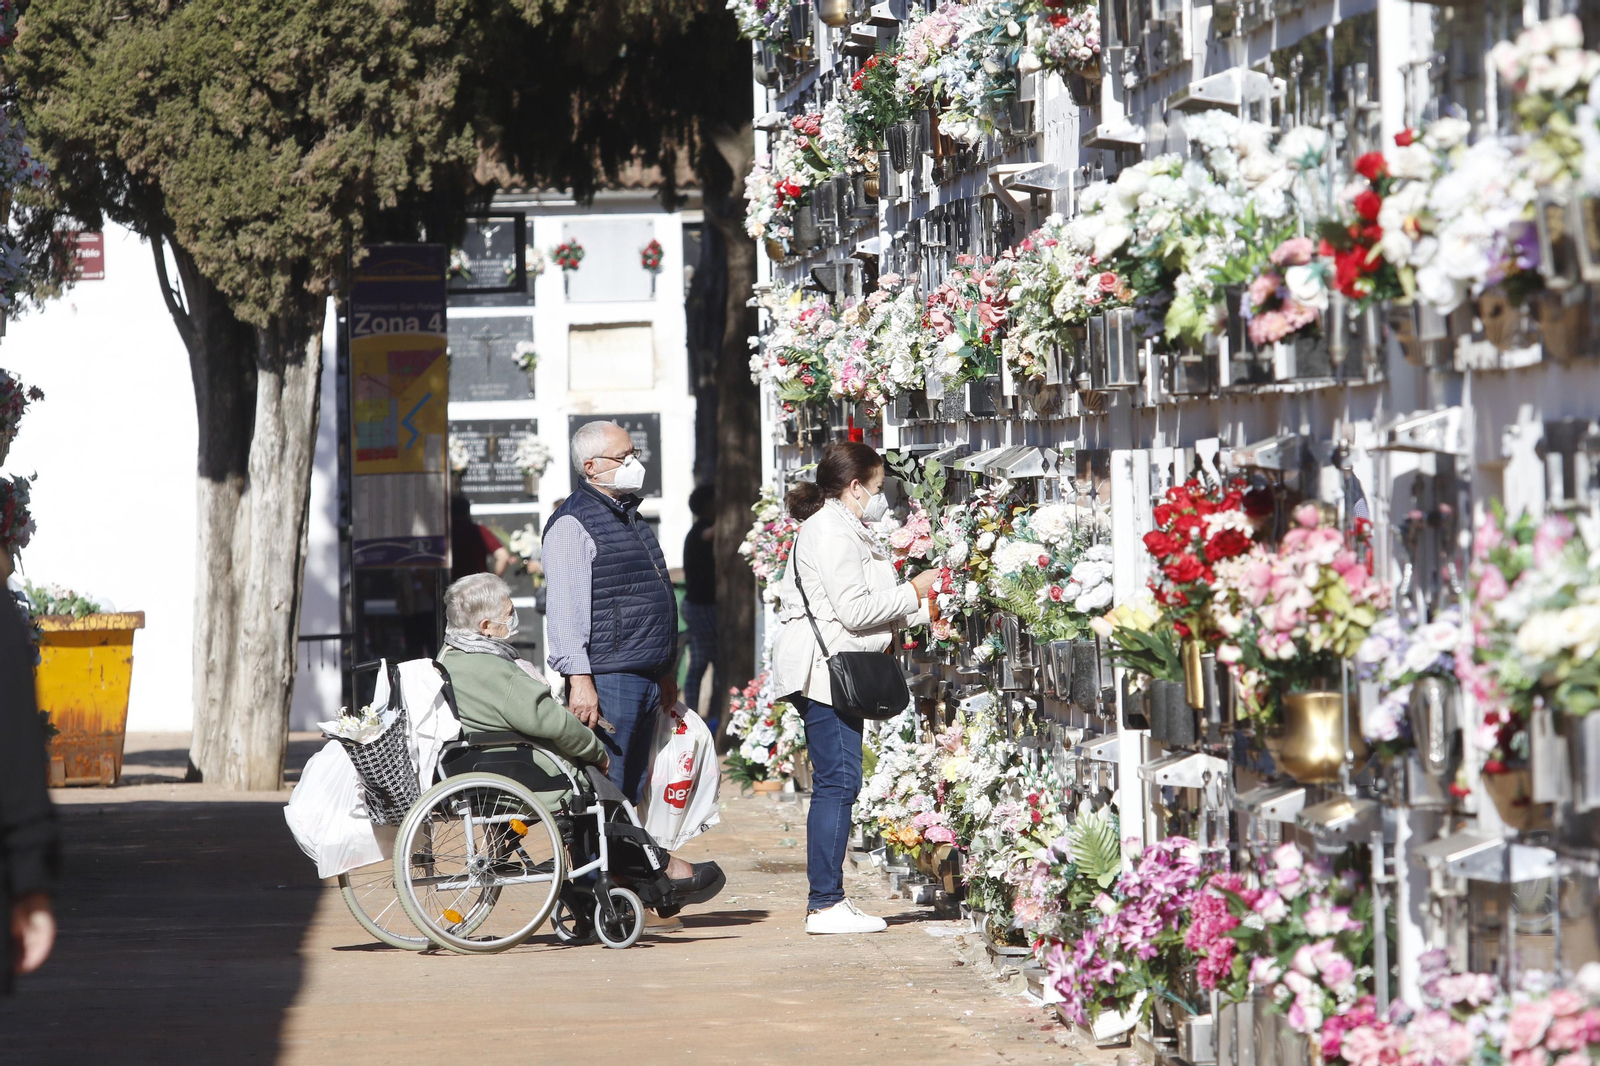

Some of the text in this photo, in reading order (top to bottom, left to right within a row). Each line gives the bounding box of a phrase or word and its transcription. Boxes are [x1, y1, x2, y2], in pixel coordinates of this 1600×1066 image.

[400, 303, 415, 311] San
[354, 312, 443, 334] Zona 4
